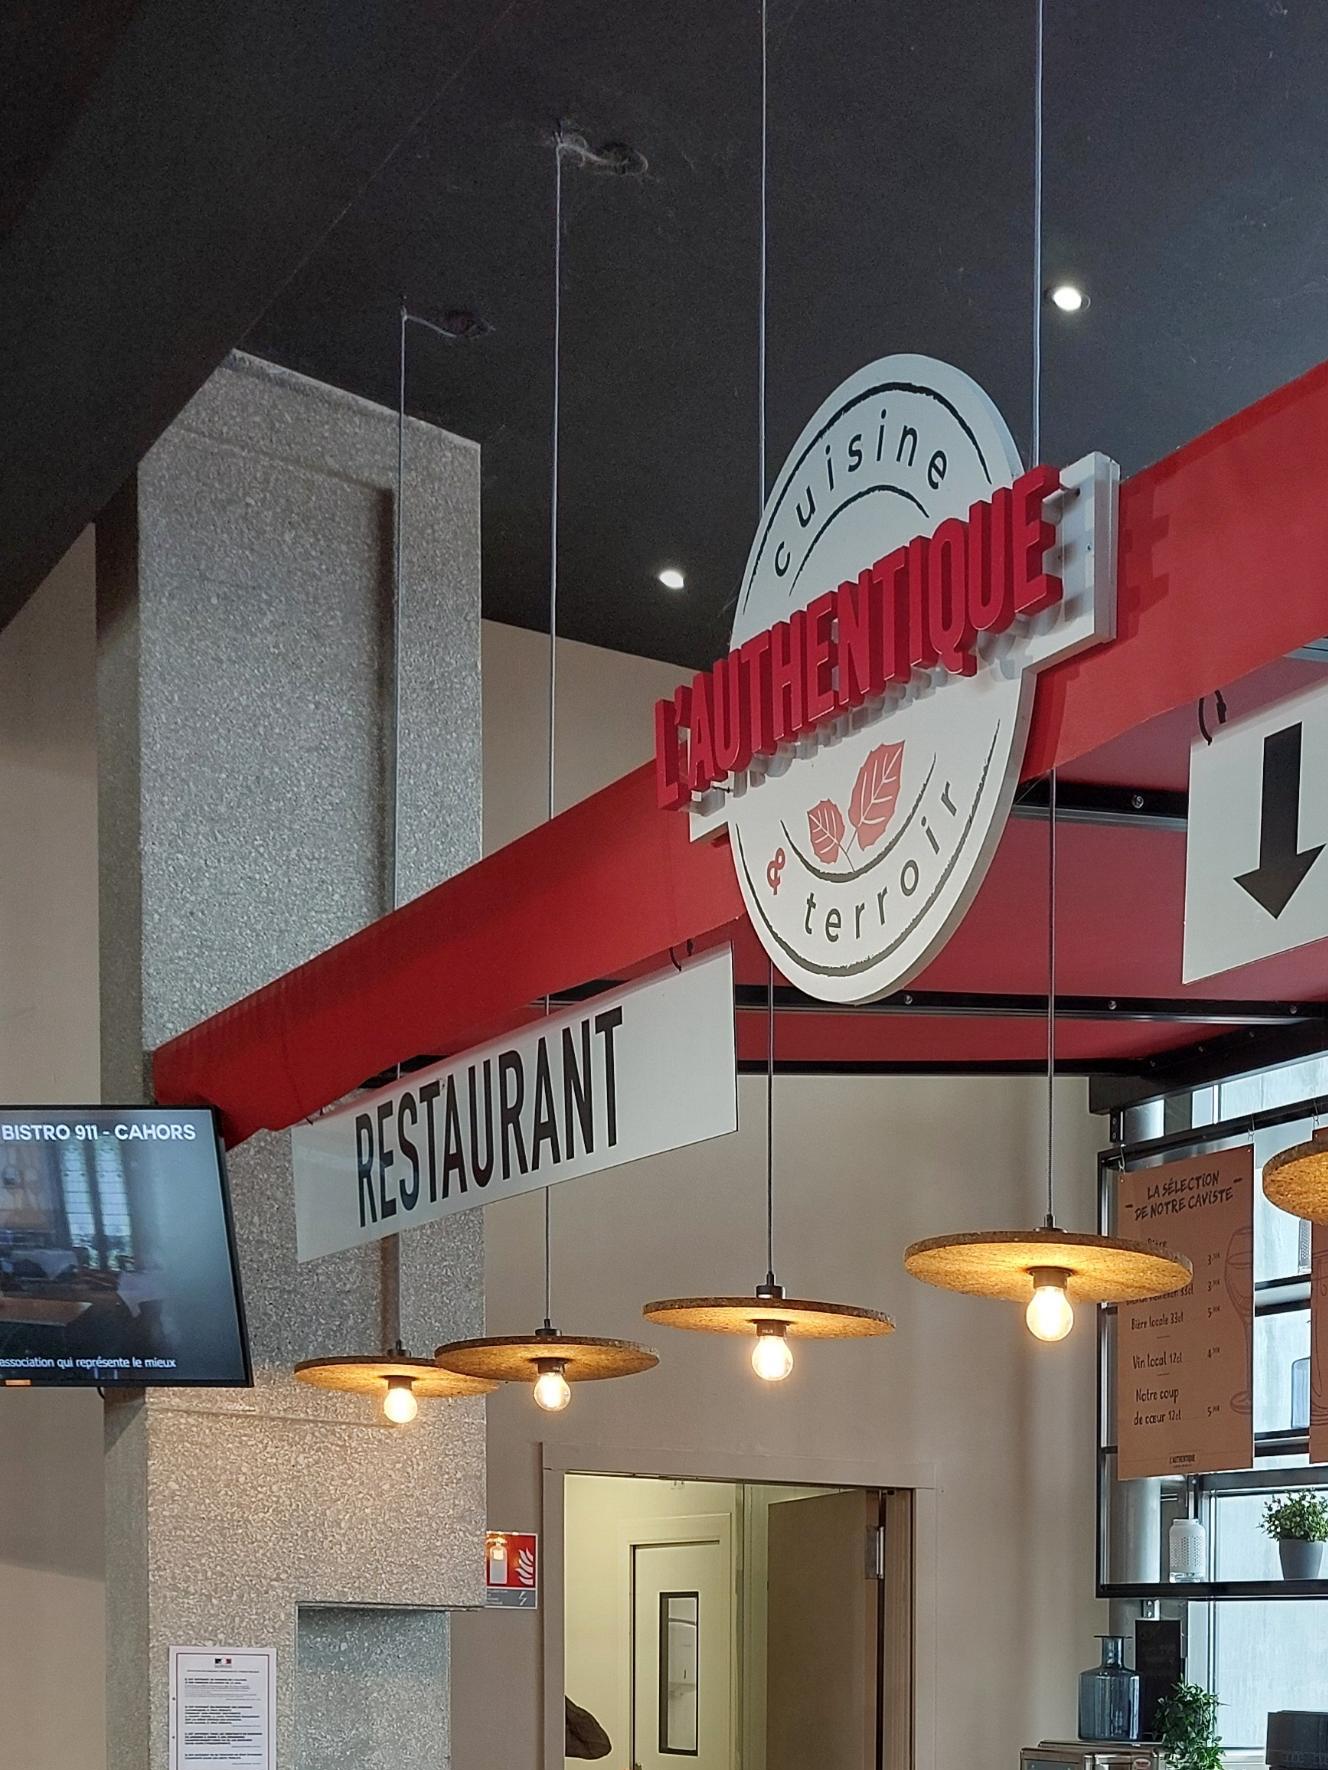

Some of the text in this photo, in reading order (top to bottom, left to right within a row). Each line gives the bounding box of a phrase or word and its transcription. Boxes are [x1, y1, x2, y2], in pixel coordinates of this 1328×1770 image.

[774, 407, 949, 579] cuisine
[654, 463, 1063, 812] L'AUTHENTIQUE
[802, 778, 957, 943] terroir
[1, 1123, 71, 1142] BISTRO
[75, 1123, 98, 1142] 911
[114, 1123, 197, 1142] CAHORS
[355, 1004, 624, 1229] RESTAURANT
[1147, 1169, 1220, 1201] LA SÉLECTION
[1134, 1186, 1234, 1221] DE NOTRE CAVISTE
[57, 1357, 74, 1370] qui
[76, 1355, 131, 1370] représente
[132, 1356, 143, 1369] le
[145, 1356, 177, 1369] mieux
[1132, 1355, 1146, 1370] Vin
[1147, 1351, 1168, 1368] local
[1135, 1387, 1180, 1404] Notre coup
[1133, 1411, 1143, 1426] de
